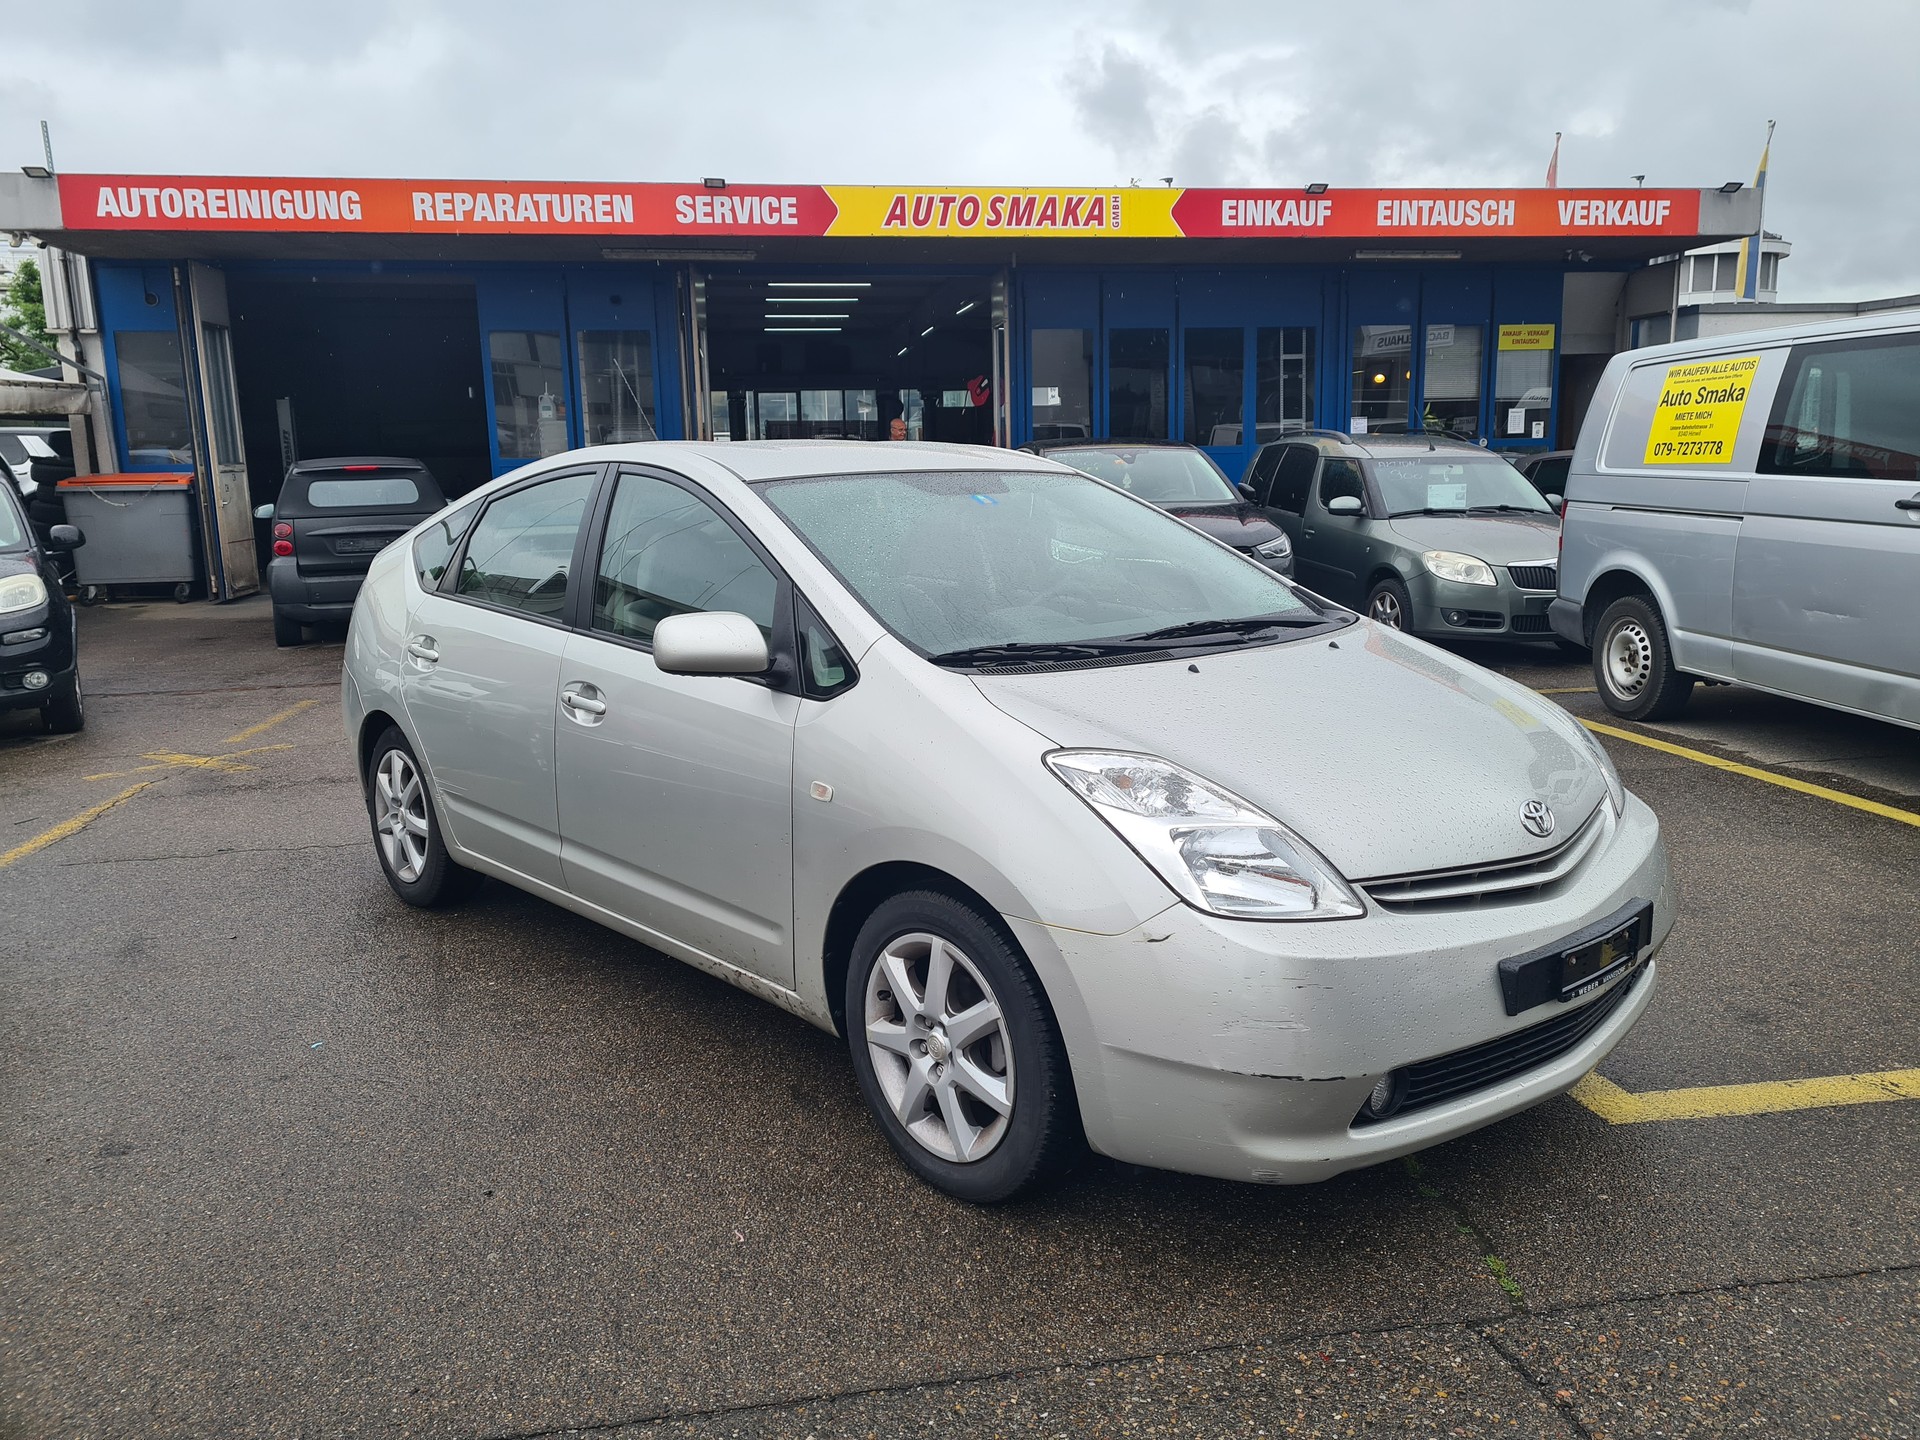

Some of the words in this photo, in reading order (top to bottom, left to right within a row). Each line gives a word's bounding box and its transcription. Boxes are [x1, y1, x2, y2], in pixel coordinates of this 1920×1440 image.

[96, 186, 363, 221] AUTOREINIGUNG
[411, 191, 634, 224] REPARATUREN
[675, 194, 798, 226] SERVICE
[883, 195, 980, 227] AUTO
[985, 195, 1106, 228] SMAKA
[1111, 195, 1120, 229] GMBH
[1221, 199, 1332, 227] EINKAUF
[1376, 199, 1515, 227] EINTAUSCH
[1557, 199, 1671, 227] VERKAUF
[1502, 330, 1522, 338] ANKAUF
[1668, 369, 1682, 378] WIR
[1682, 365, 1710, 377] KAUFEN
[1710, 364, 1729, 374] ALLE
[1730, 360, 1756, 372] AUTOS
[1660, 390, 1692, 408] Auto
[1695, 382, 1746, 405] Smaka
[1674, 412, 1694, 421] MIETE
[1695, 410, 1713, 420] MICH
[1653, 441, 1723, 456] 079-7273778
[1578, 980, 1599, 996] WEBER
